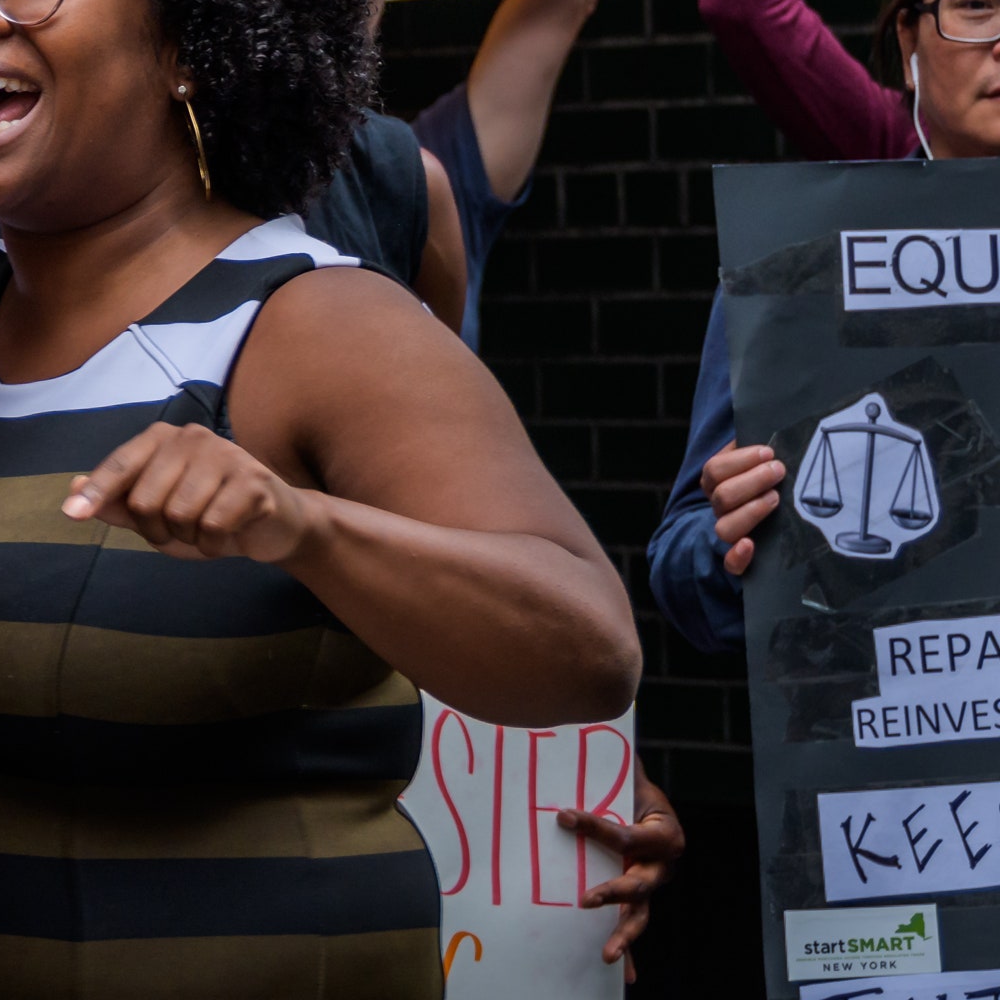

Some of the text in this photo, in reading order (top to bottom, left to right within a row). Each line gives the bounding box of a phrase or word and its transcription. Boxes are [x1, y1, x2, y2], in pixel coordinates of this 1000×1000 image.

[846, 233, 1000, 298] EQU
[888, 630, 1000, 677] REPA
[840, 790, 993, 885] KEE
[804, 936, 915, 955] startSMART
[822, 960, 898, 972] NEW YORK
